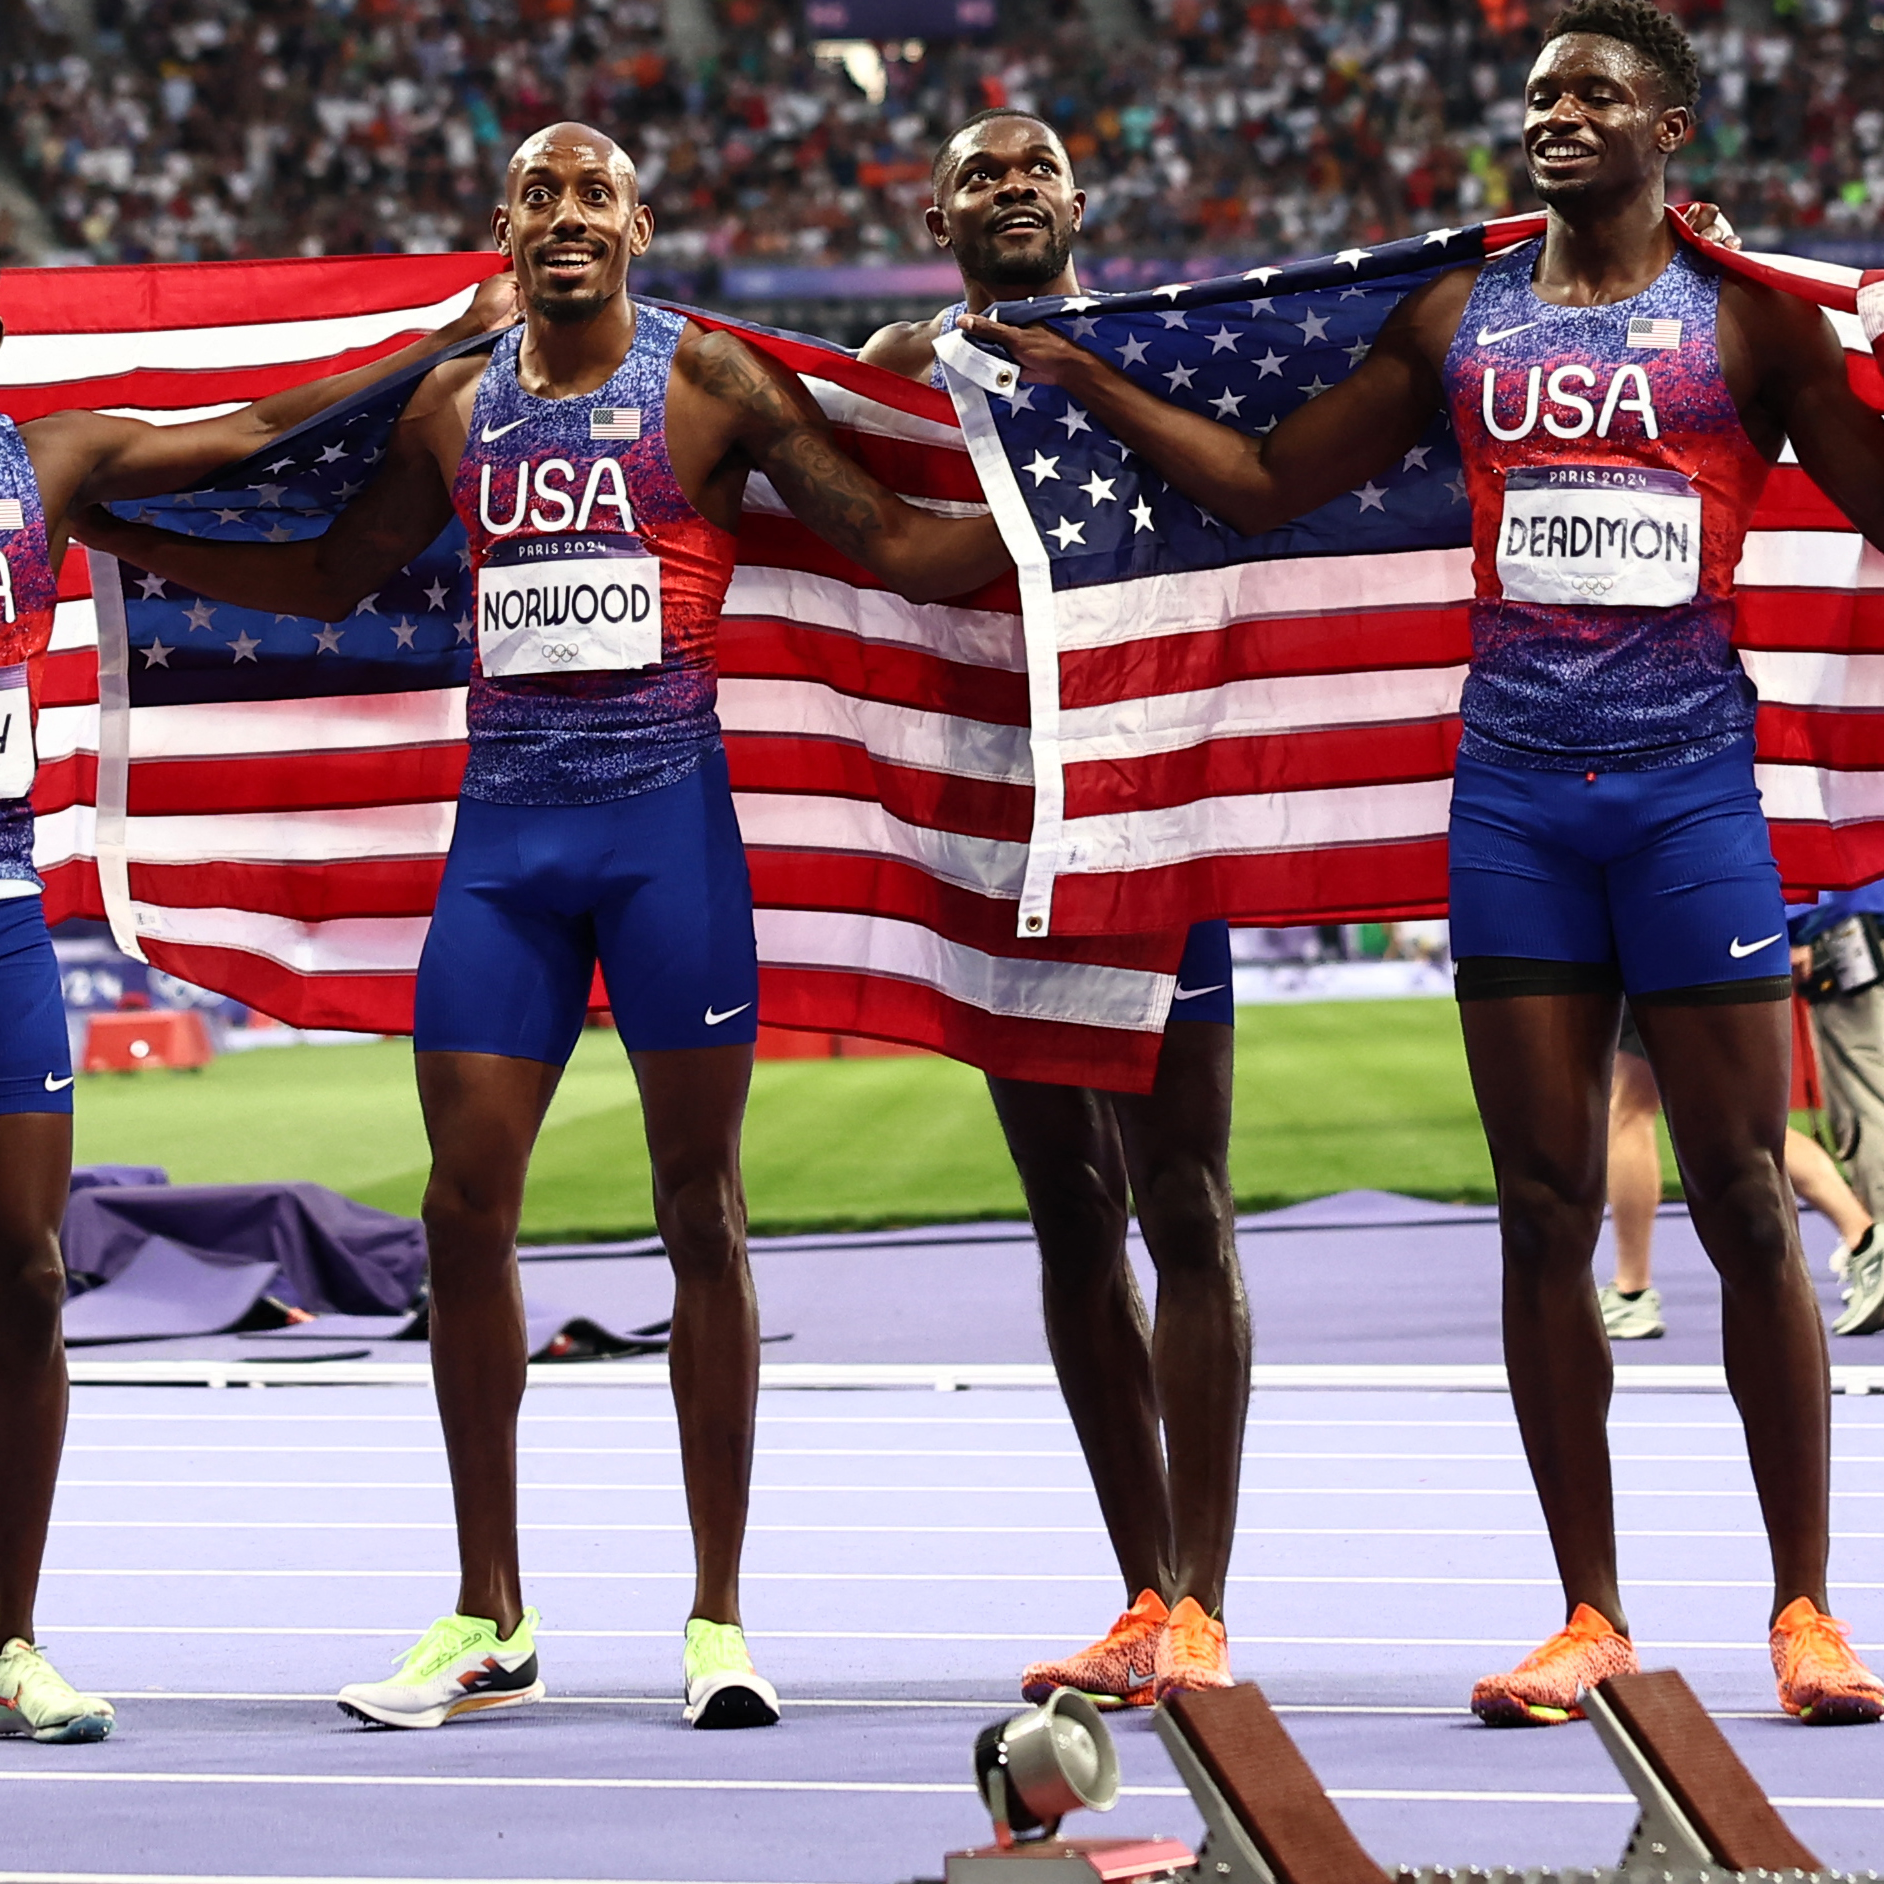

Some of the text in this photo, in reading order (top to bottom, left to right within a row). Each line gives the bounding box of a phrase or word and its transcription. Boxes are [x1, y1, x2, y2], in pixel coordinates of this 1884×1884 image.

[1482, 365, 1659, 441] USA
[479, 457, 635, 534] USA
[1549, 470, 1647, 487] PARIS 2024
[518, 540, 606, 558] PARIS 2024
[1506, 515, 1687, 563] DEADMON
[483, 583, 651, 633] NORWOOD
